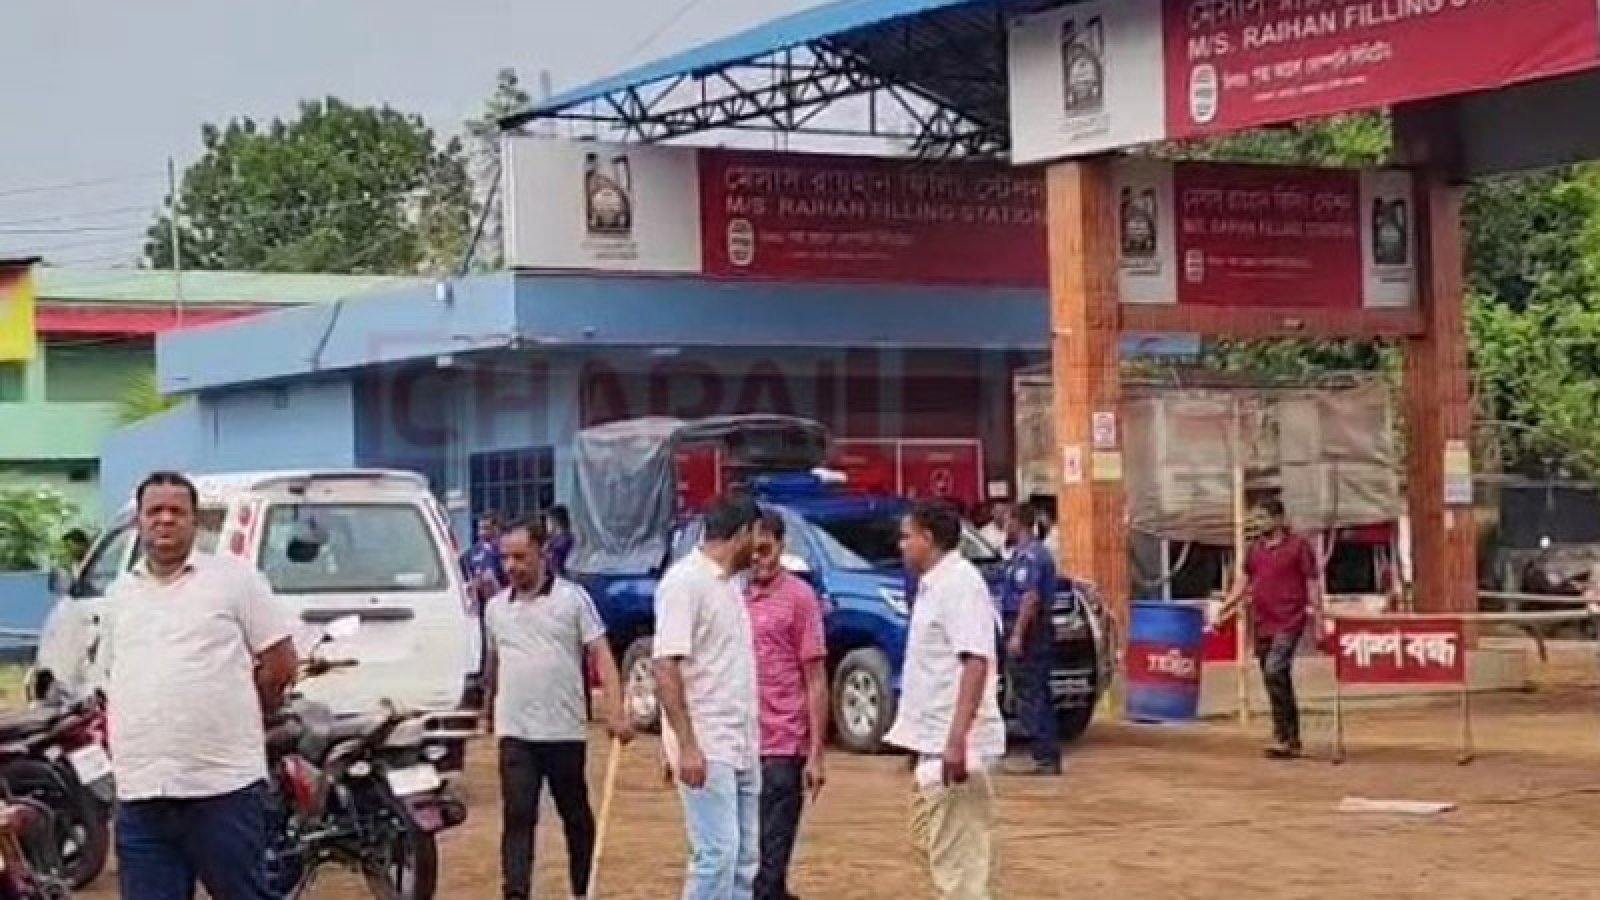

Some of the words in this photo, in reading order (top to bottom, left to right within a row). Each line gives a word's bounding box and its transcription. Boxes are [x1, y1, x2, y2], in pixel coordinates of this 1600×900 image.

[1242, 10, 1336, 50] RAIHAN
[1344, 0, 1443, 30] FILLING
[779, 198, 865, 218] RAIHAN
[1339, 627, 1402, 668] পাম্প
[1403, 631, 1457, 668] বন্ধ
